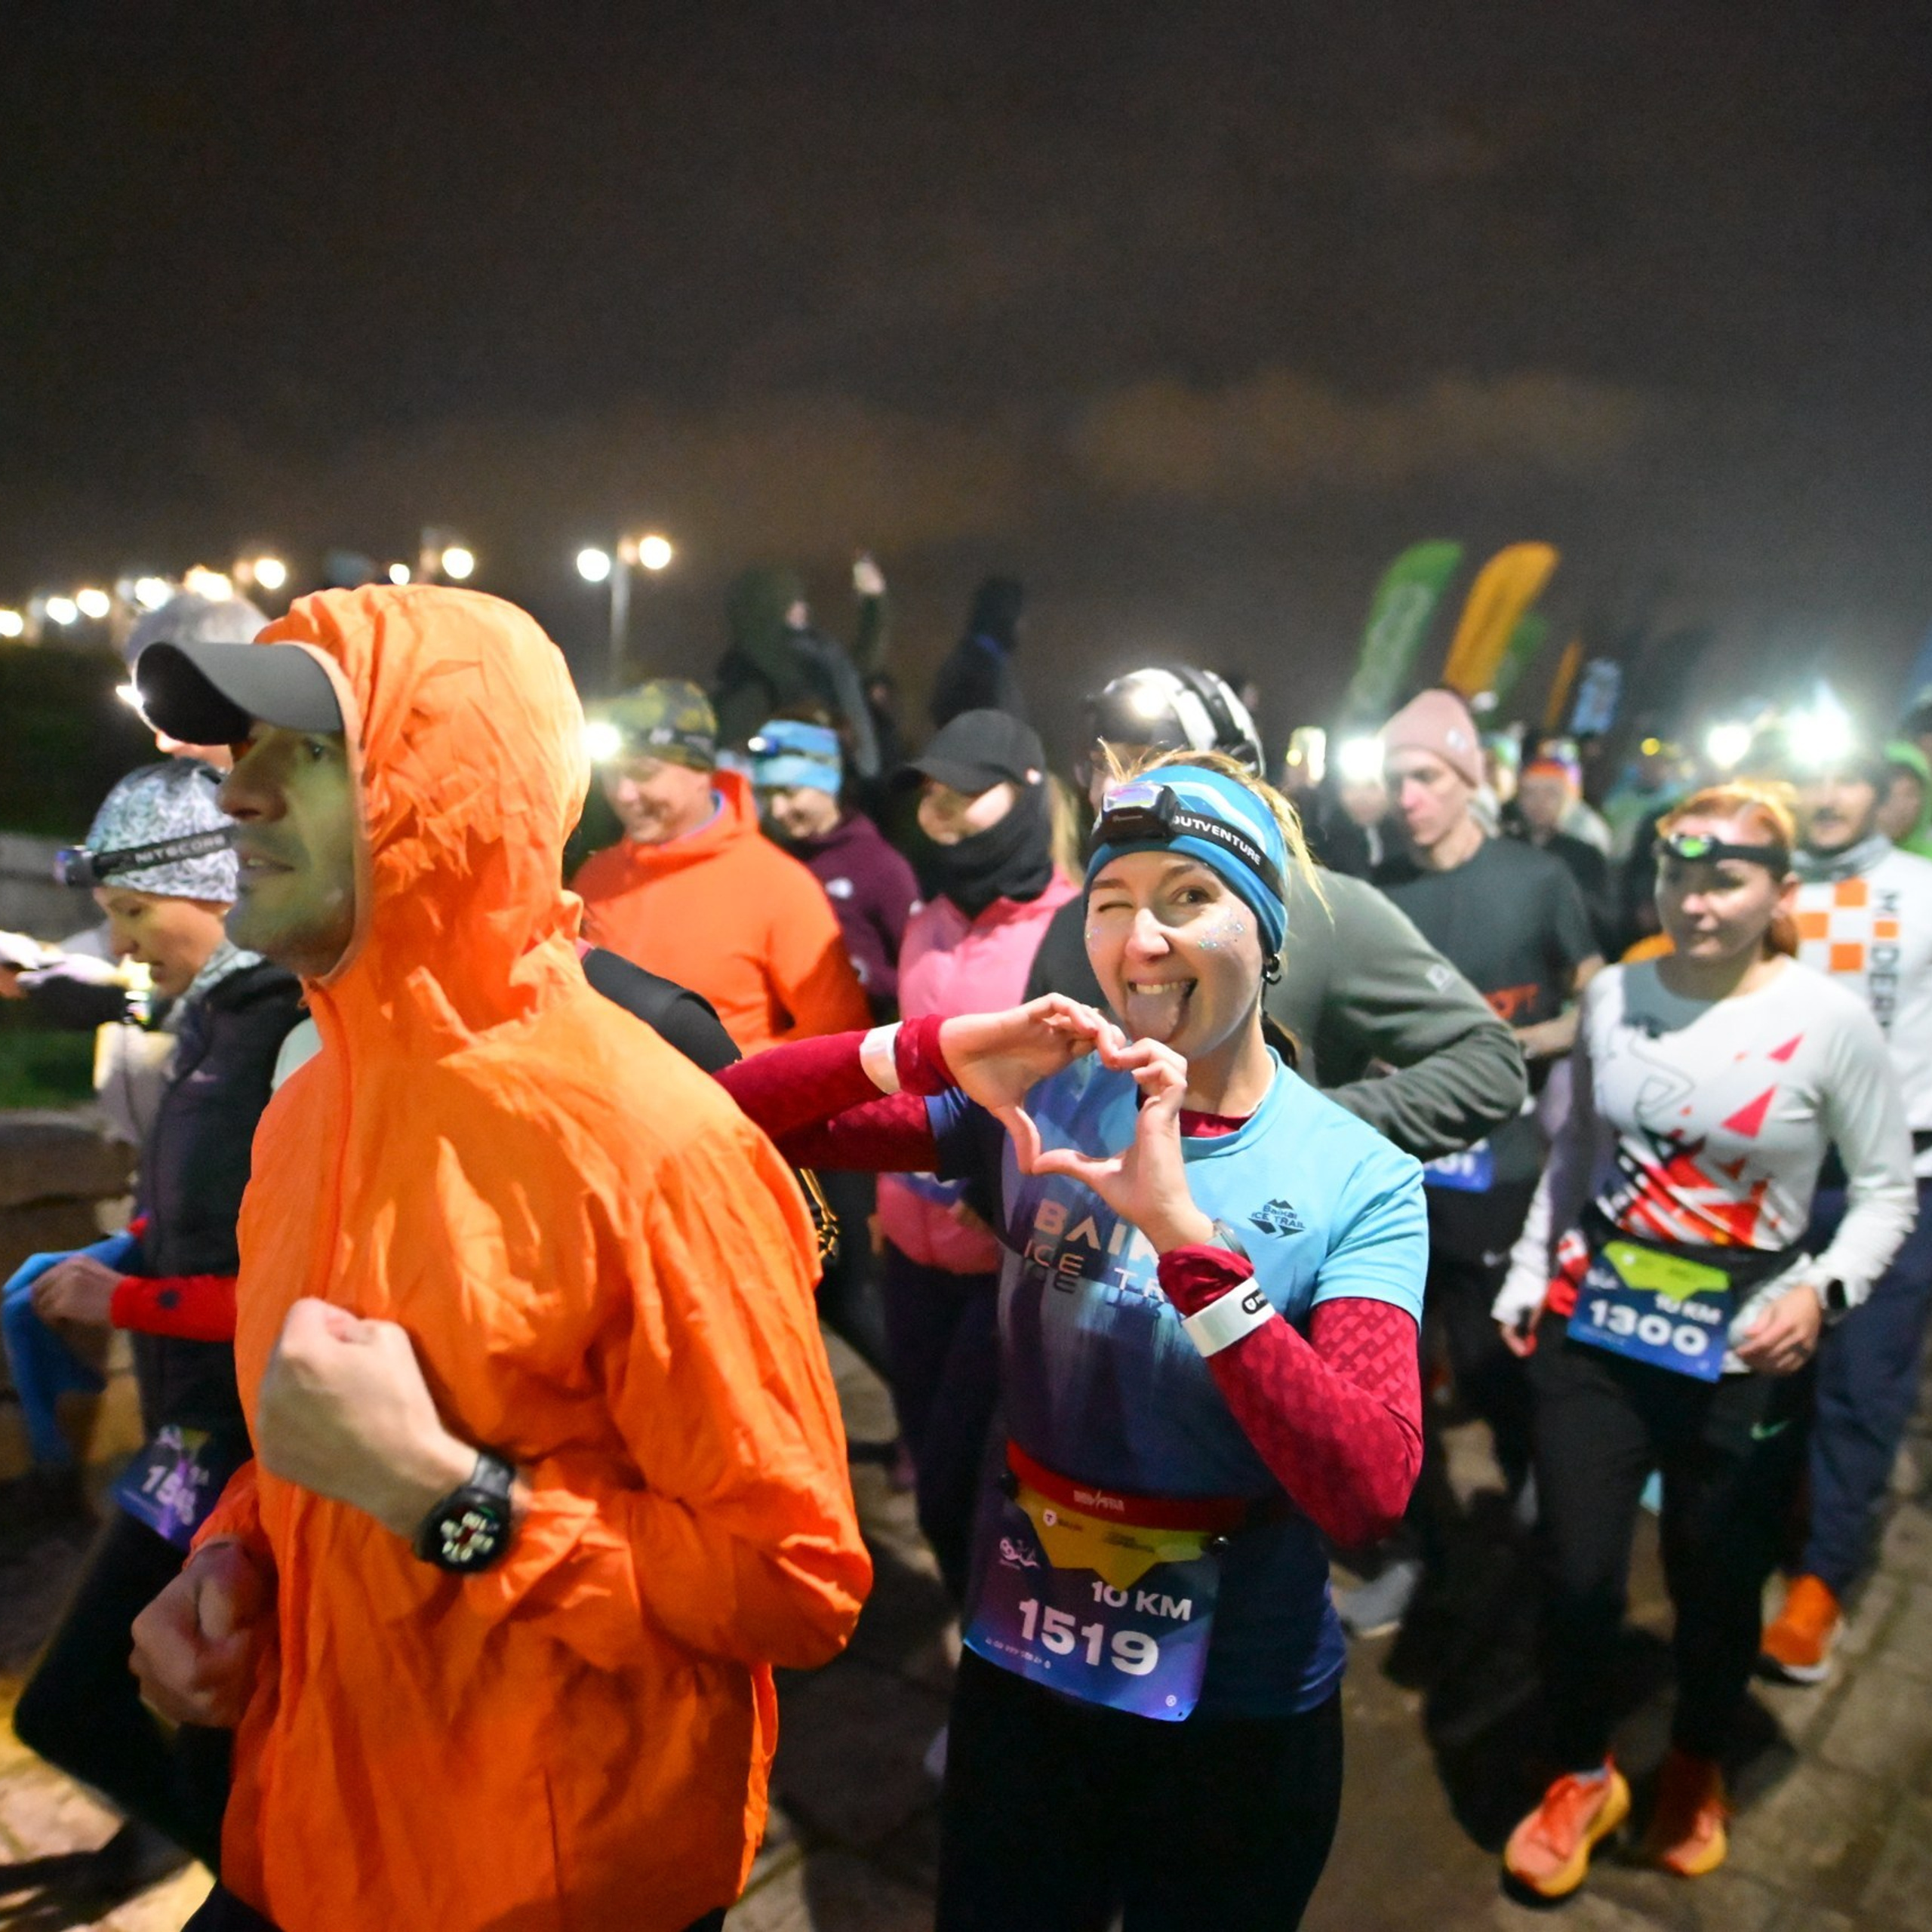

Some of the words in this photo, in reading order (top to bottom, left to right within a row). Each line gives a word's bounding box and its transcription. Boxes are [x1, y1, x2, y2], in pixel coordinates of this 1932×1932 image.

[1274, 1216, 1306, 1229] TRAIL
[1024, 1240, 1084, 1275] ICE
[1589, 1299, 1709, 1357] 1300
[1092, 1581, 1128, 1607] 10
[1135, 1589, 1192, 1621] KM
[1018, 1597, 1159, 1676] 1519
